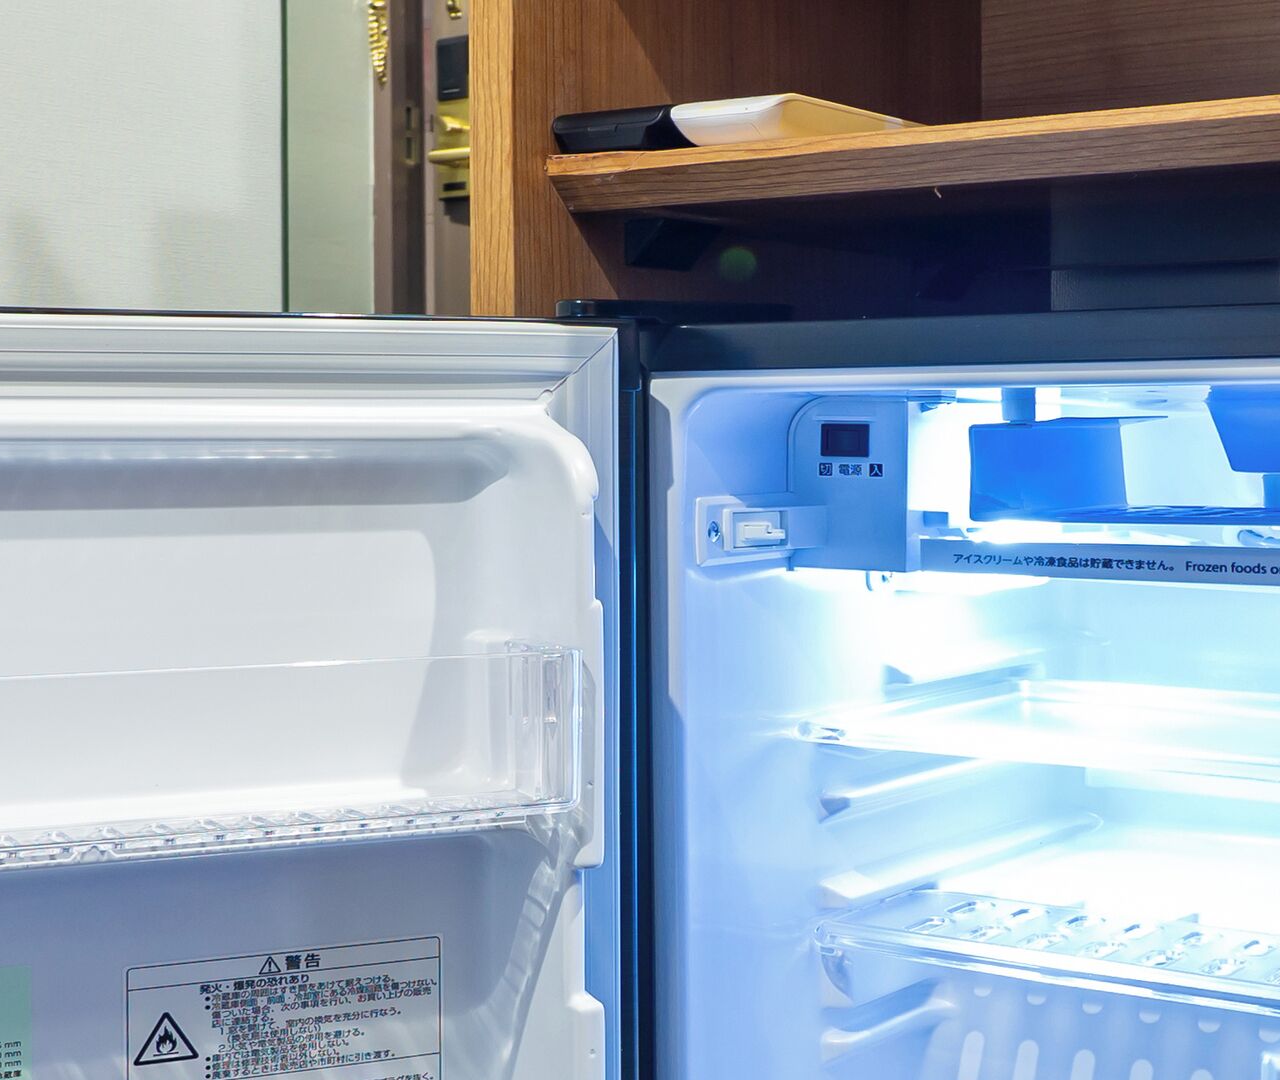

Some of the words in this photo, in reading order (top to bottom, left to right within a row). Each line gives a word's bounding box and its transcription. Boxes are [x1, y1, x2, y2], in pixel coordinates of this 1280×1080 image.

[819, 463, 833, 476] 切
[839, 464, 862, 476] 電源
[953, 553, 1175, 571] アイスクリームや冷凍食品は貯蔵できません。
[1185, 560, 1228, 574] Frozen
[1231, 562, 1267, 575] foods
[284, 951, 321, 971] 警告
[3, 1039, 21, 1049] mm
[4, 1049, 21, 1058] mm
[4, 1059, 21, 1068] mm
